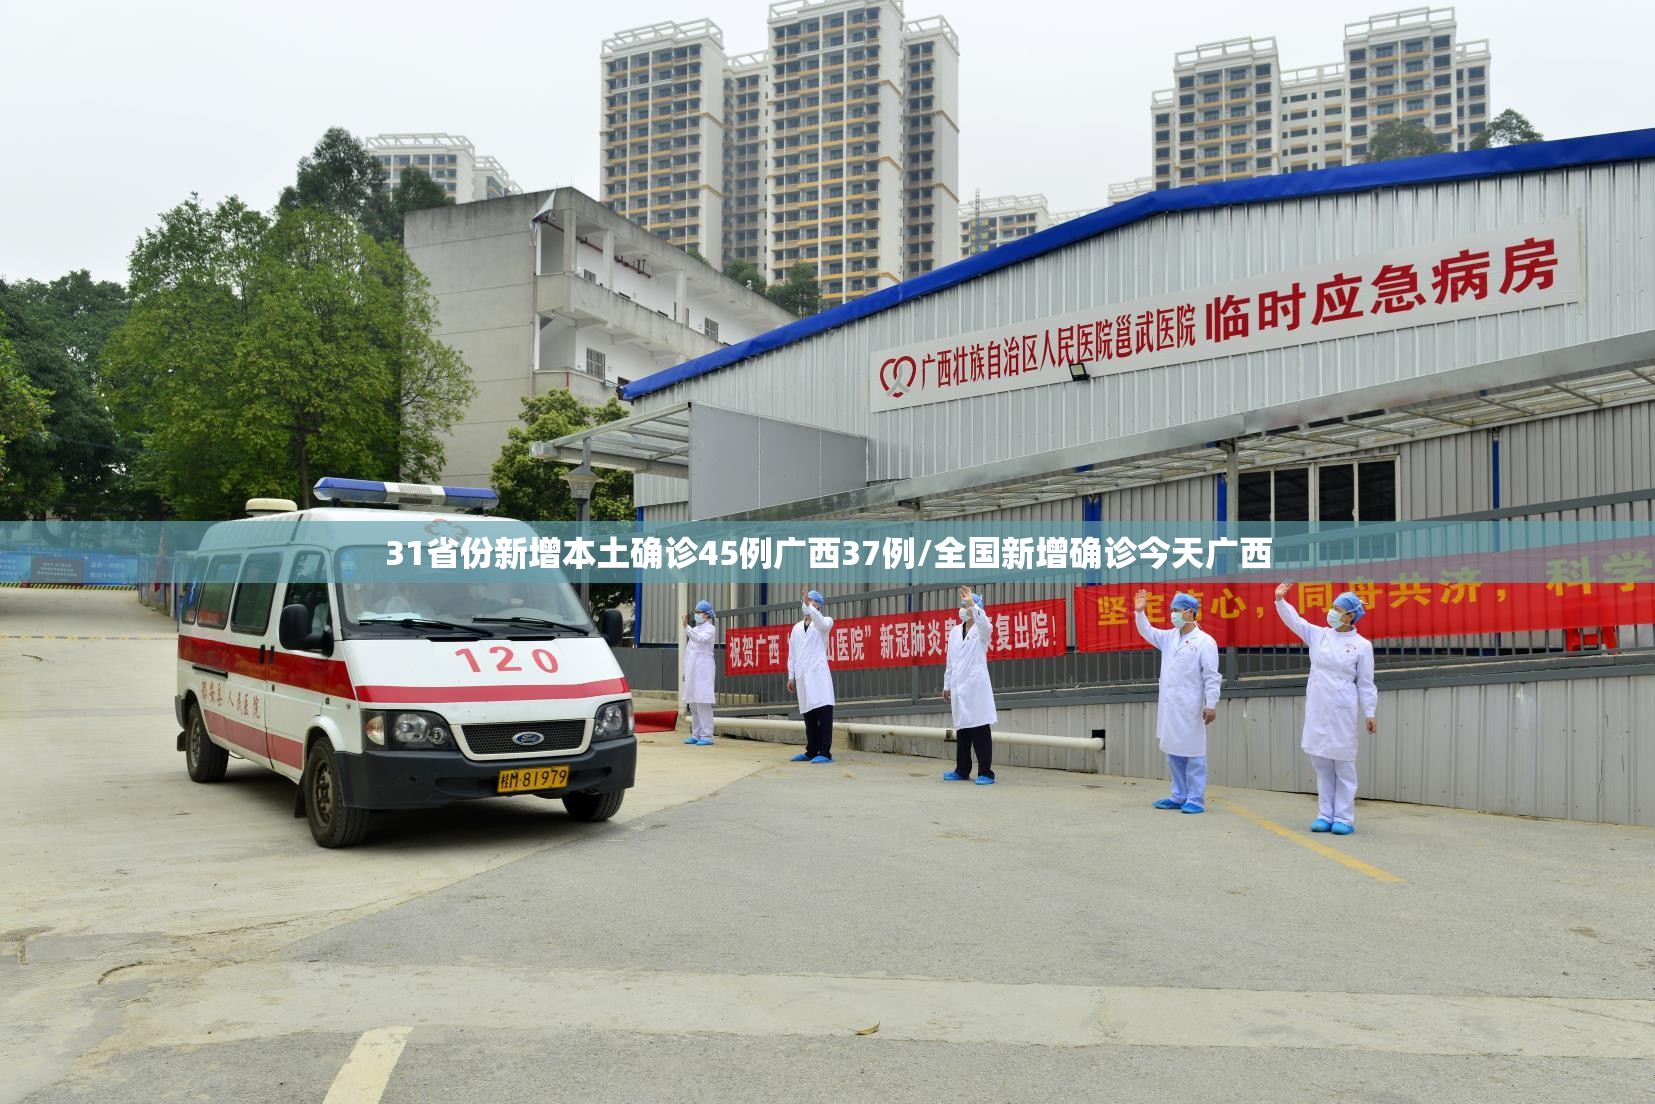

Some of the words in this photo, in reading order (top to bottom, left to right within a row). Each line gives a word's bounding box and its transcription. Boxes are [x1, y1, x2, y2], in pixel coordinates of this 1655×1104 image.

[921, 303, 1196, 390] 广西壮族自治区人民医院邕武医院
[1205, 237, 1558, 343] 临时应急病房
[455, 646, 559, 674] 120
